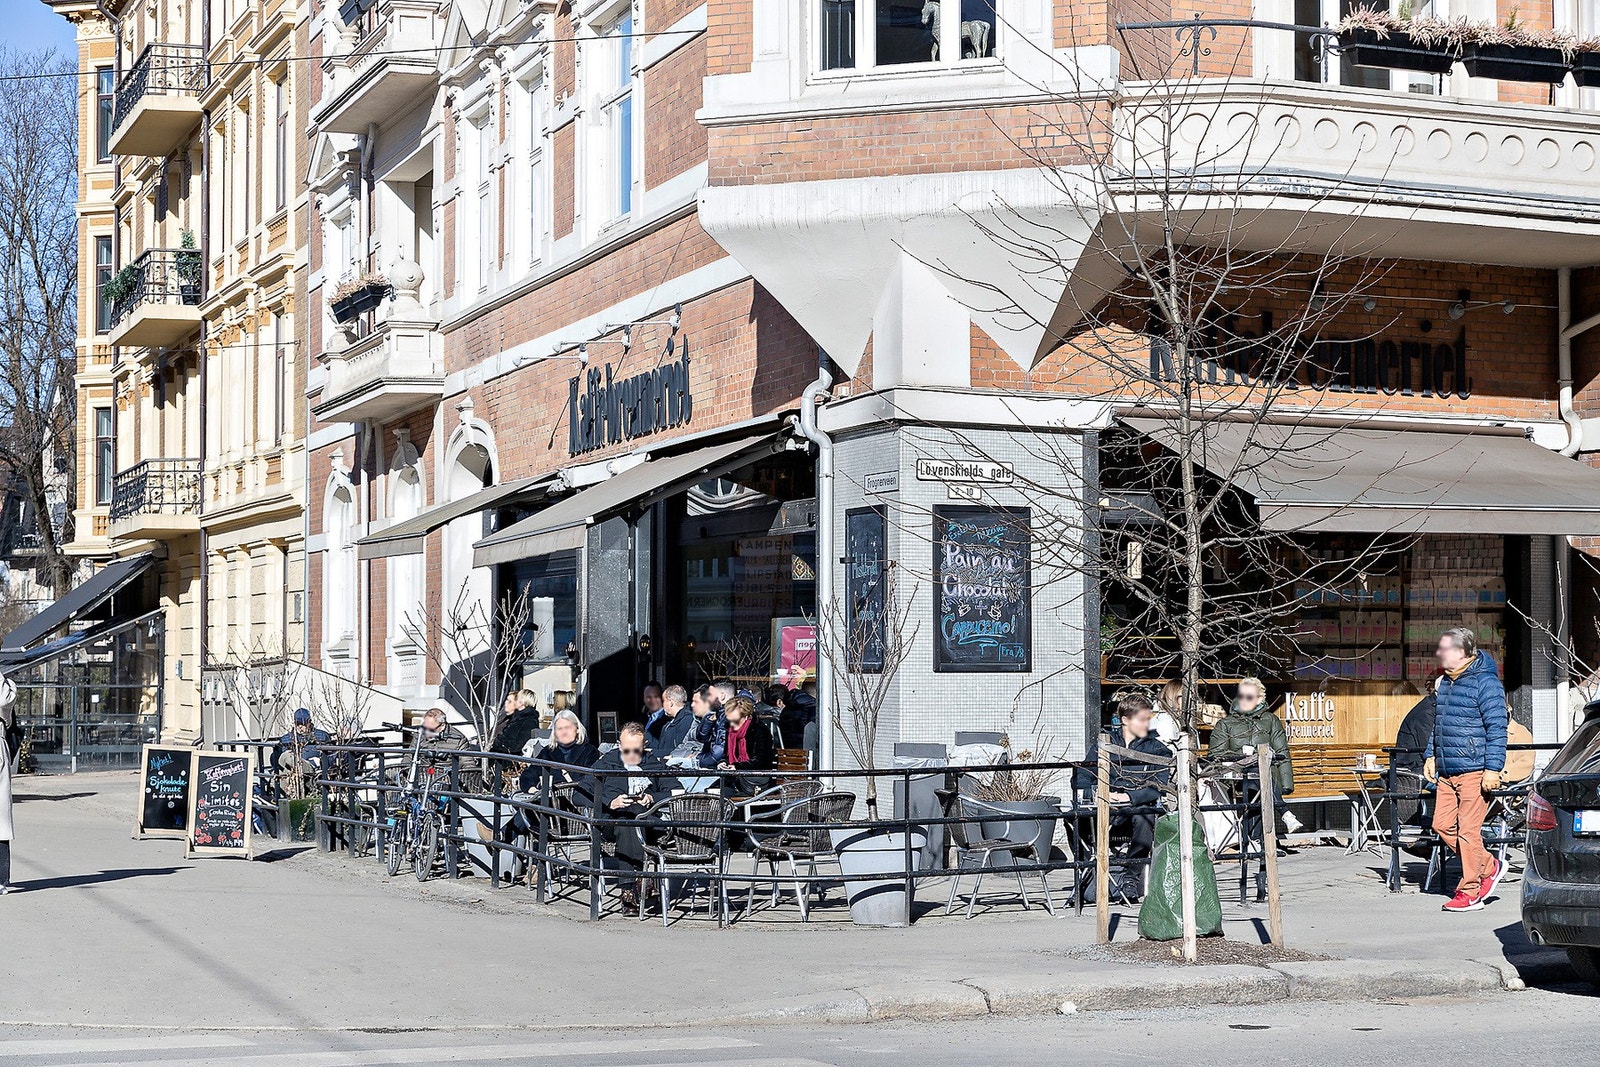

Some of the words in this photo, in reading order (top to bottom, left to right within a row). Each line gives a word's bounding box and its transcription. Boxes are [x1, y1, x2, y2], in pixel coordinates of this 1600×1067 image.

[990, 465, 1011, 481] gate
[866, 475, 897, 490] Frognerveien
[946, 540, 985, 568] Pain
[1001, 646, 1014, 657] Fra
[1285, 691, 1334, 721] Kaffe
[1285, 722, 1334, 738] brenneriet
[210, 781, 231, 792] Sin
[205, 794, 240, 806] Limites
